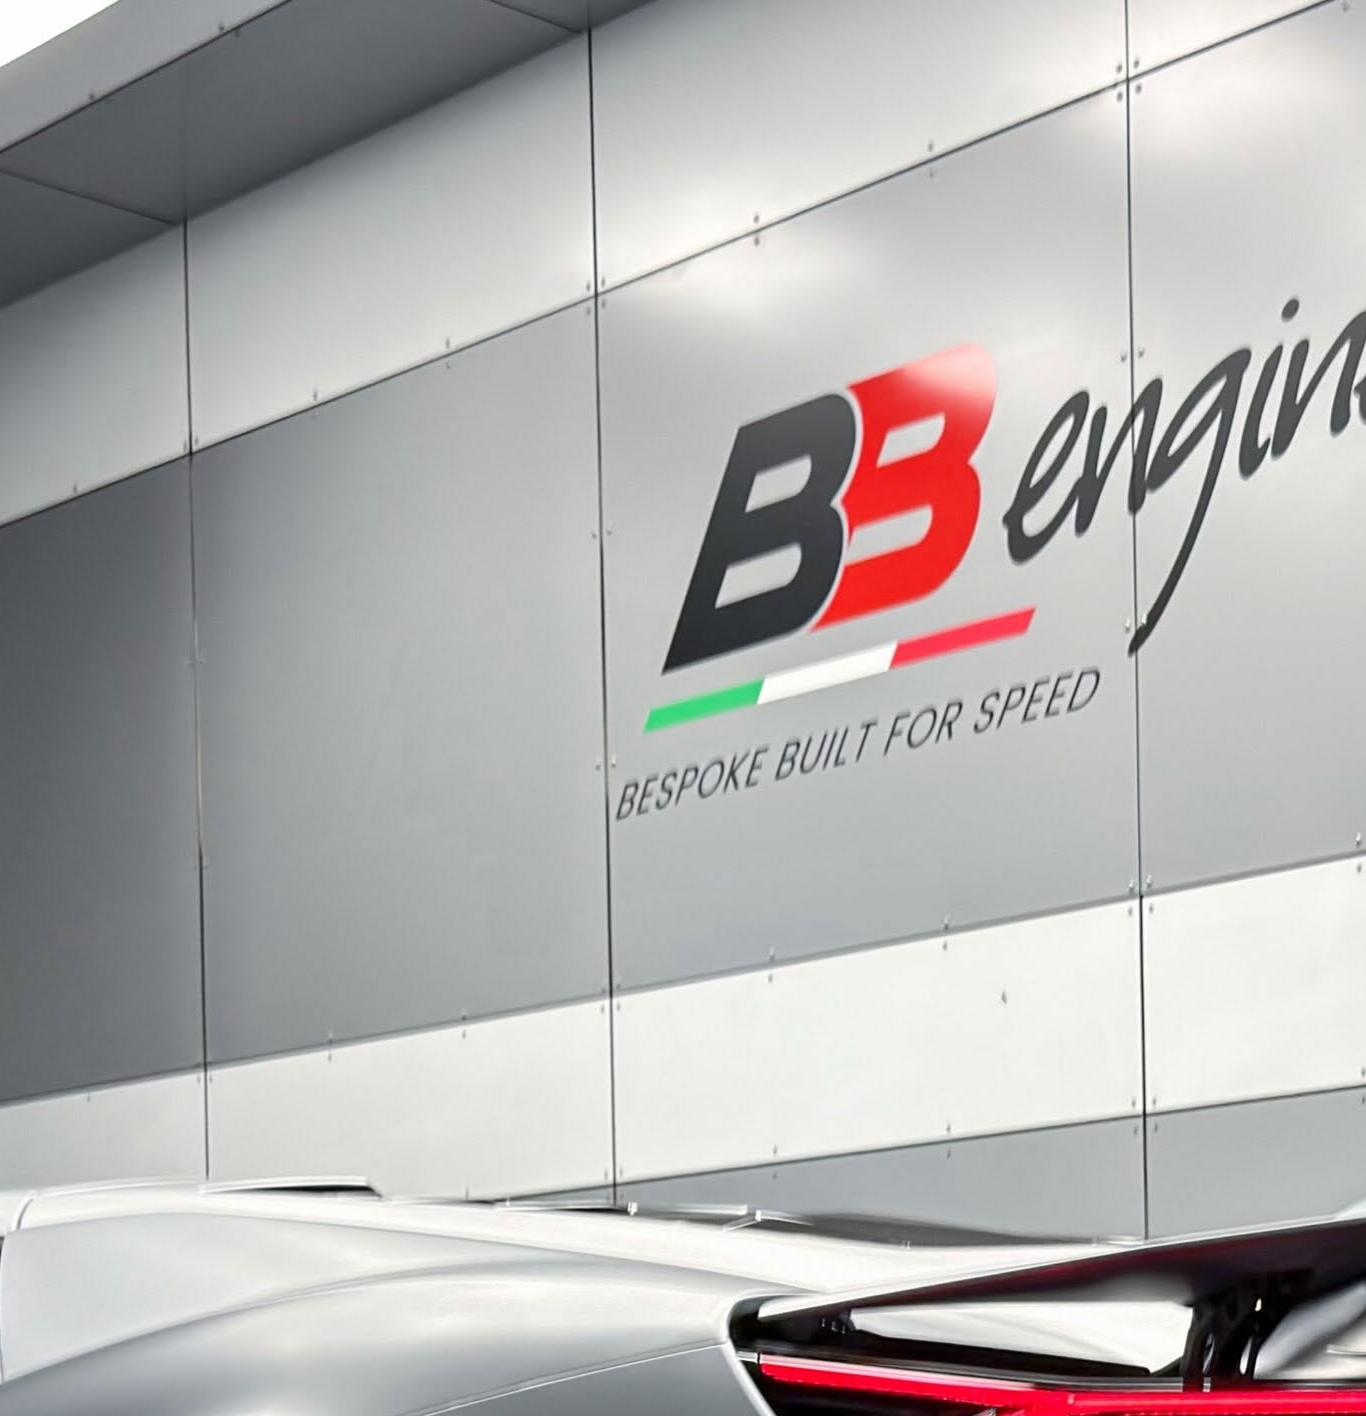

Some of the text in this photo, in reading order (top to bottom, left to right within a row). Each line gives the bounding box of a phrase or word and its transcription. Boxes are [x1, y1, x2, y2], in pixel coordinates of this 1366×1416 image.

[661, 342, 998, 676] BB
[615, 666, 1102, 822] BESPOKE BUILT FOR SPEED
